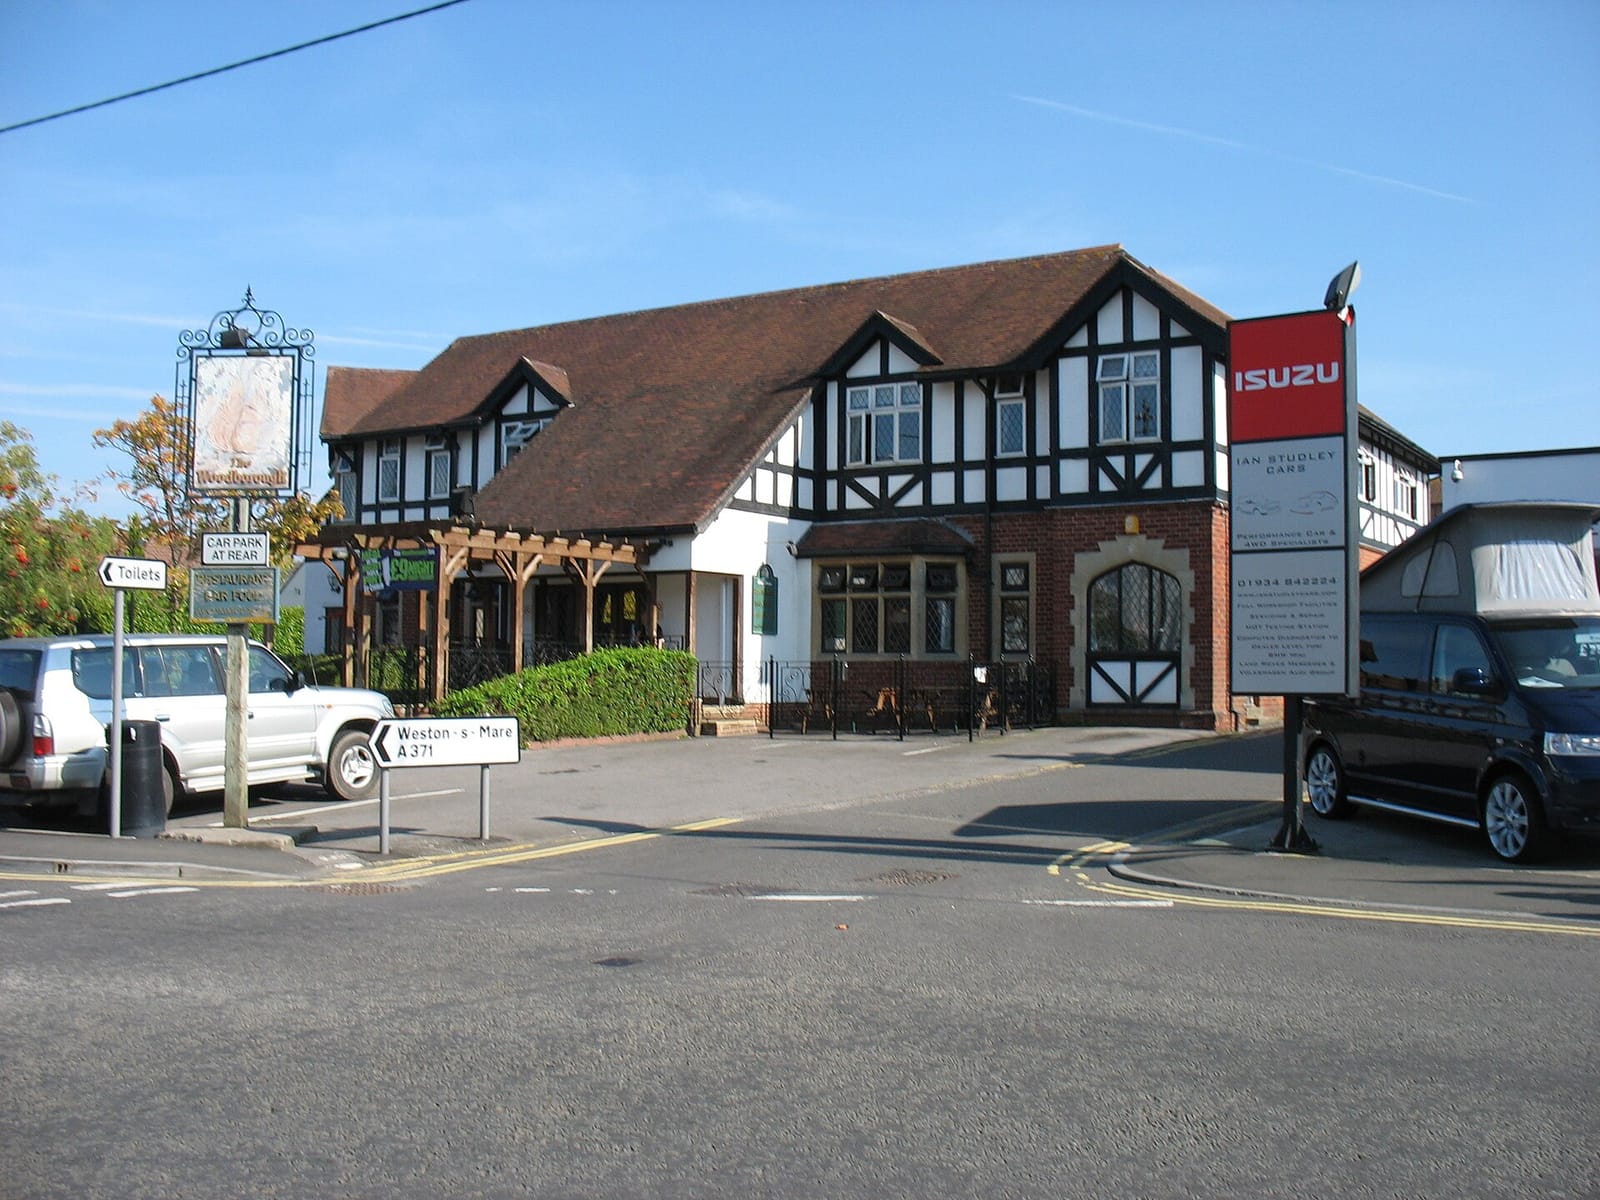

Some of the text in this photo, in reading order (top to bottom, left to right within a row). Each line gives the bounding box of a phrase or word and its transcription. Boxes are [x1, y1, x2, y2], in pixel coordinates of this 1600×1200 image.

[1235, 361, 1339, 392] ISUZU
[1236, 450, 1335, 465] IAN STUDLEY
[1266, 464, 1306, 475] CARS
[196, 469, 288, 486] Woodborough
[207, 537, 263, 548] CAR PARK
[212, 550, 258, 560] AT REAR
[117, 565, 161, 582] Toilets
[1238, 577, 1336, 587] 01934 842224
